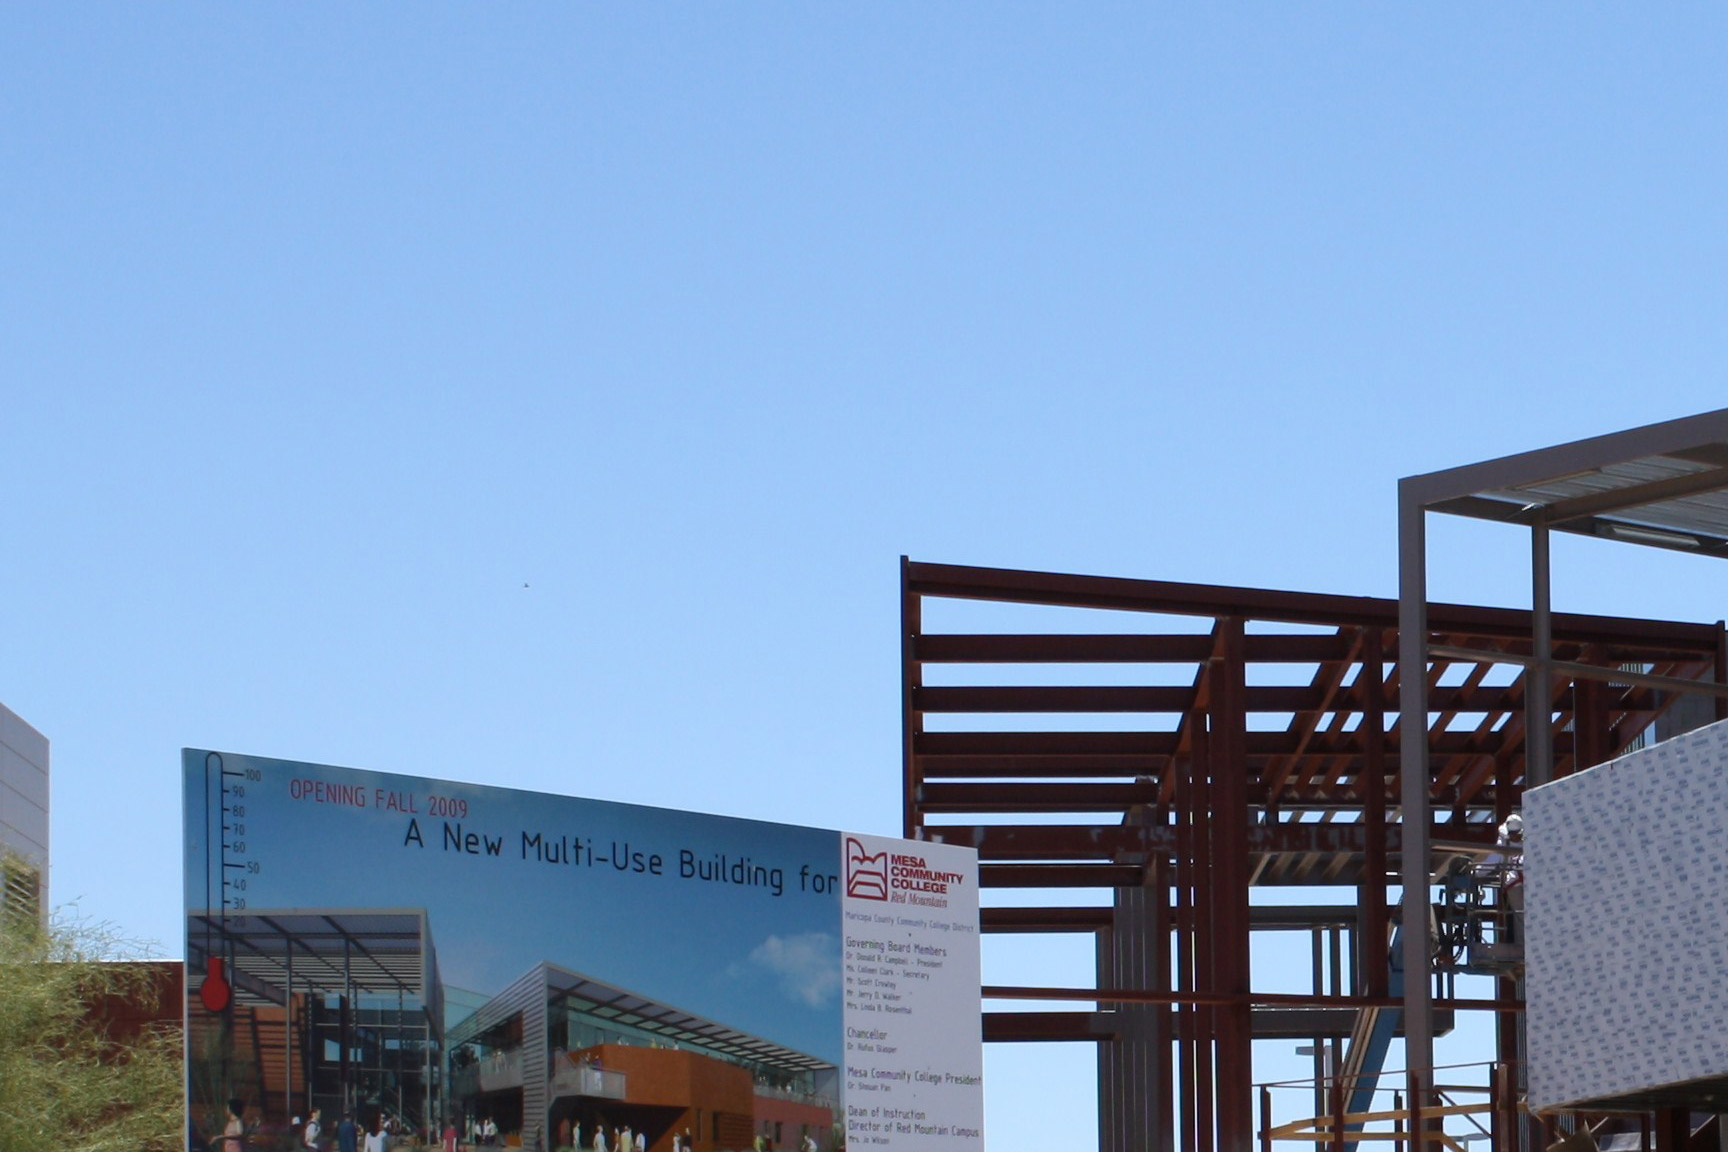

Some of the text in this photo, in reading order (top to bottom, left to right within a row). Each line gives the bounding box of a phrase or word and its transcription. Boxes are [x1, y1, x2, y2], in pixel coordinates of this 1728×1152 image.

[246, 769, 261, 782] 100
[232, 786, 245, 798] 90
[290, 778, 468, 818] OPENING FALL 2009
[233, 805, 245, 817] 80
[233, 824, 245, 836] 70
[233, 841, 246, 853] 60
[404, 818, 838, 897] A New Multi-Use Building for
[891, 854, 927, 869] MESA
[247, 862, 260, 874] 50
[891, 866, 964, 885] COMMUNITY
[233, 879, 246, 891] 40
[891, 878, 947, 894] COLLEGE
[234, 897, 246, 910] 30
[890, 891, 948, 909] Red Mountain
[846, 936, 947, 957] Governing Board Members
[847, 1027, 888, 1040] Chancellor
[847, 1066, 982, 1086] Mesa Community College President
[848, 1105, 926, 1120] Dean of Instruction
[848, 1119, 979, 1139] Director of Red Mountain Campus
